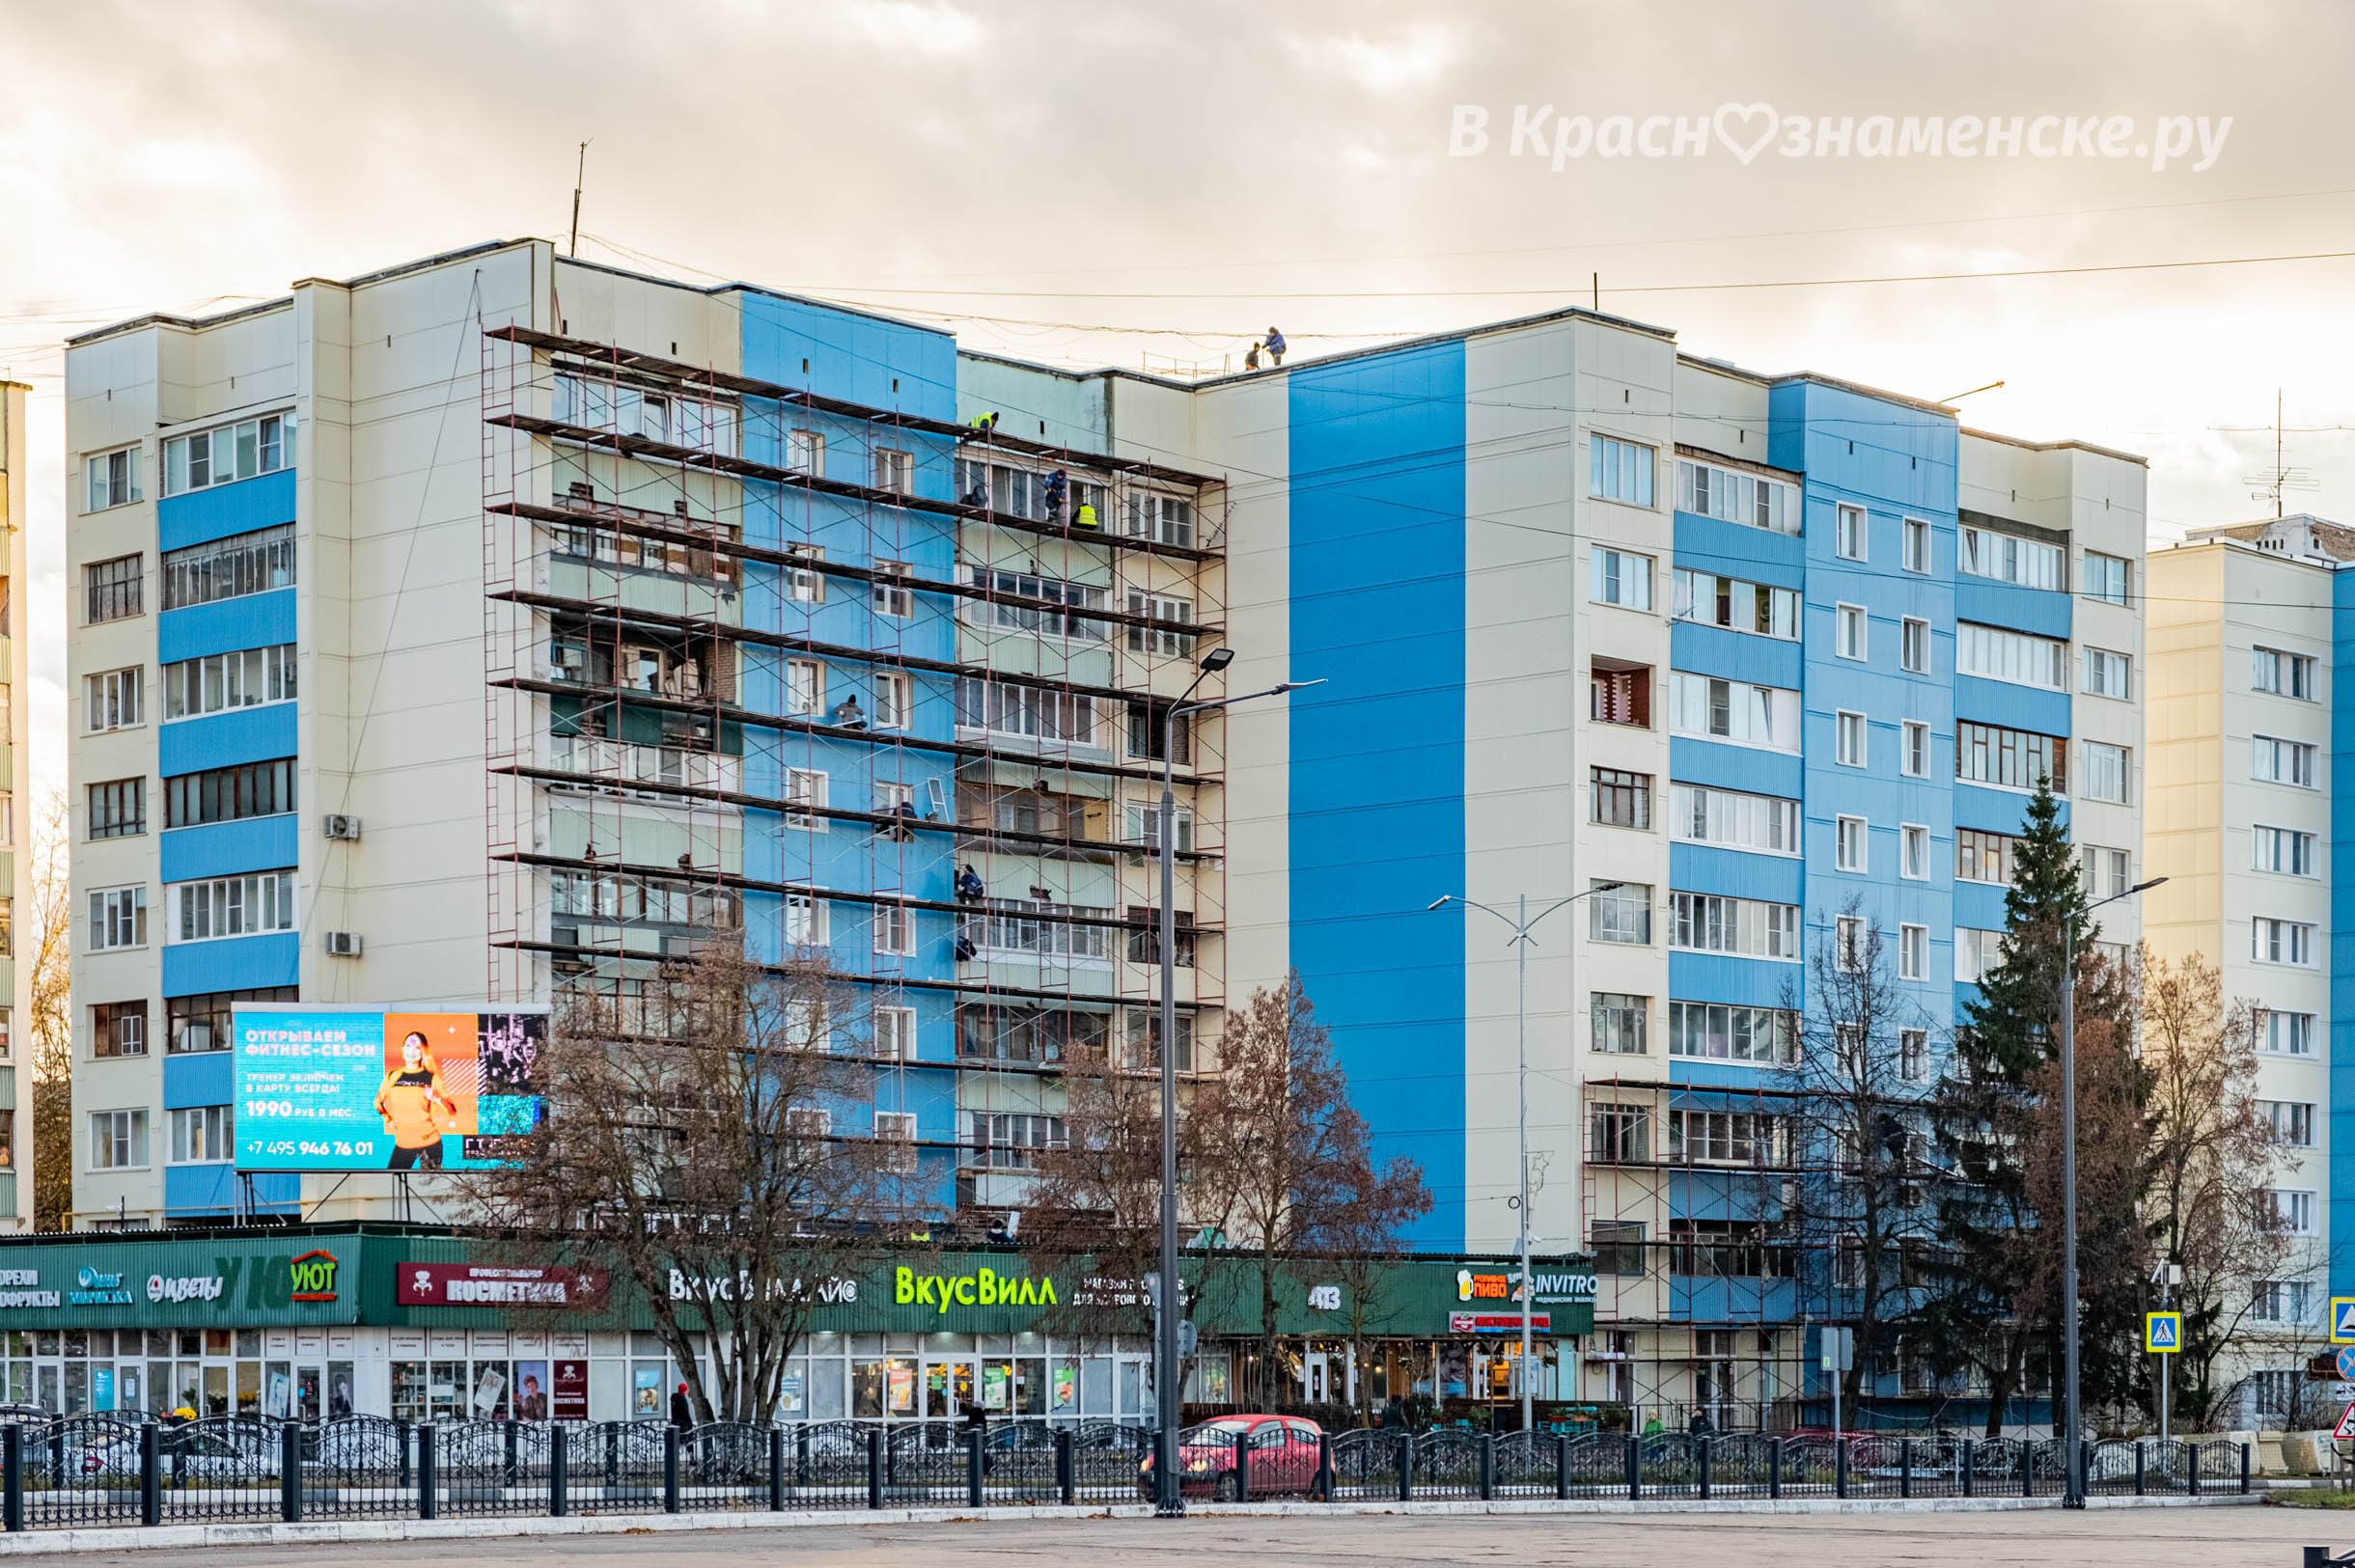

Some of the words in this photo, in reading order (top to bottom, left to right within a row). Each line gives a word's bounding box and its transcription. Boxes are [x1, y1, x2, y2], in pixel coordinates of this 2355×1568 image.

[245, 1030, 346, 1042] ОТКРЫВАЕМ
[245, 1043, 375, 1057] ФИТНЕС-СЕЗОН
[247, 1073, 287, 1082] ТРЕНЕР
[246, 1101, 293, 1116] 1990
[247, 1142, 263, 1155] +7
[266, 1142, 295, 1156] 495
[298, 1142, 330, 1156] 946
[332, 1142, 353, 1156] 76
[355, 1142, 374, 1156] 01
[291, 1263, 336, 1291] УЮТ
[896, 1266, 1058, 1314] ВкусВилл
[1473, 1283, 1508, 1297] ПИВО
[1536, 1275, 1598, 1294] INVITRO
